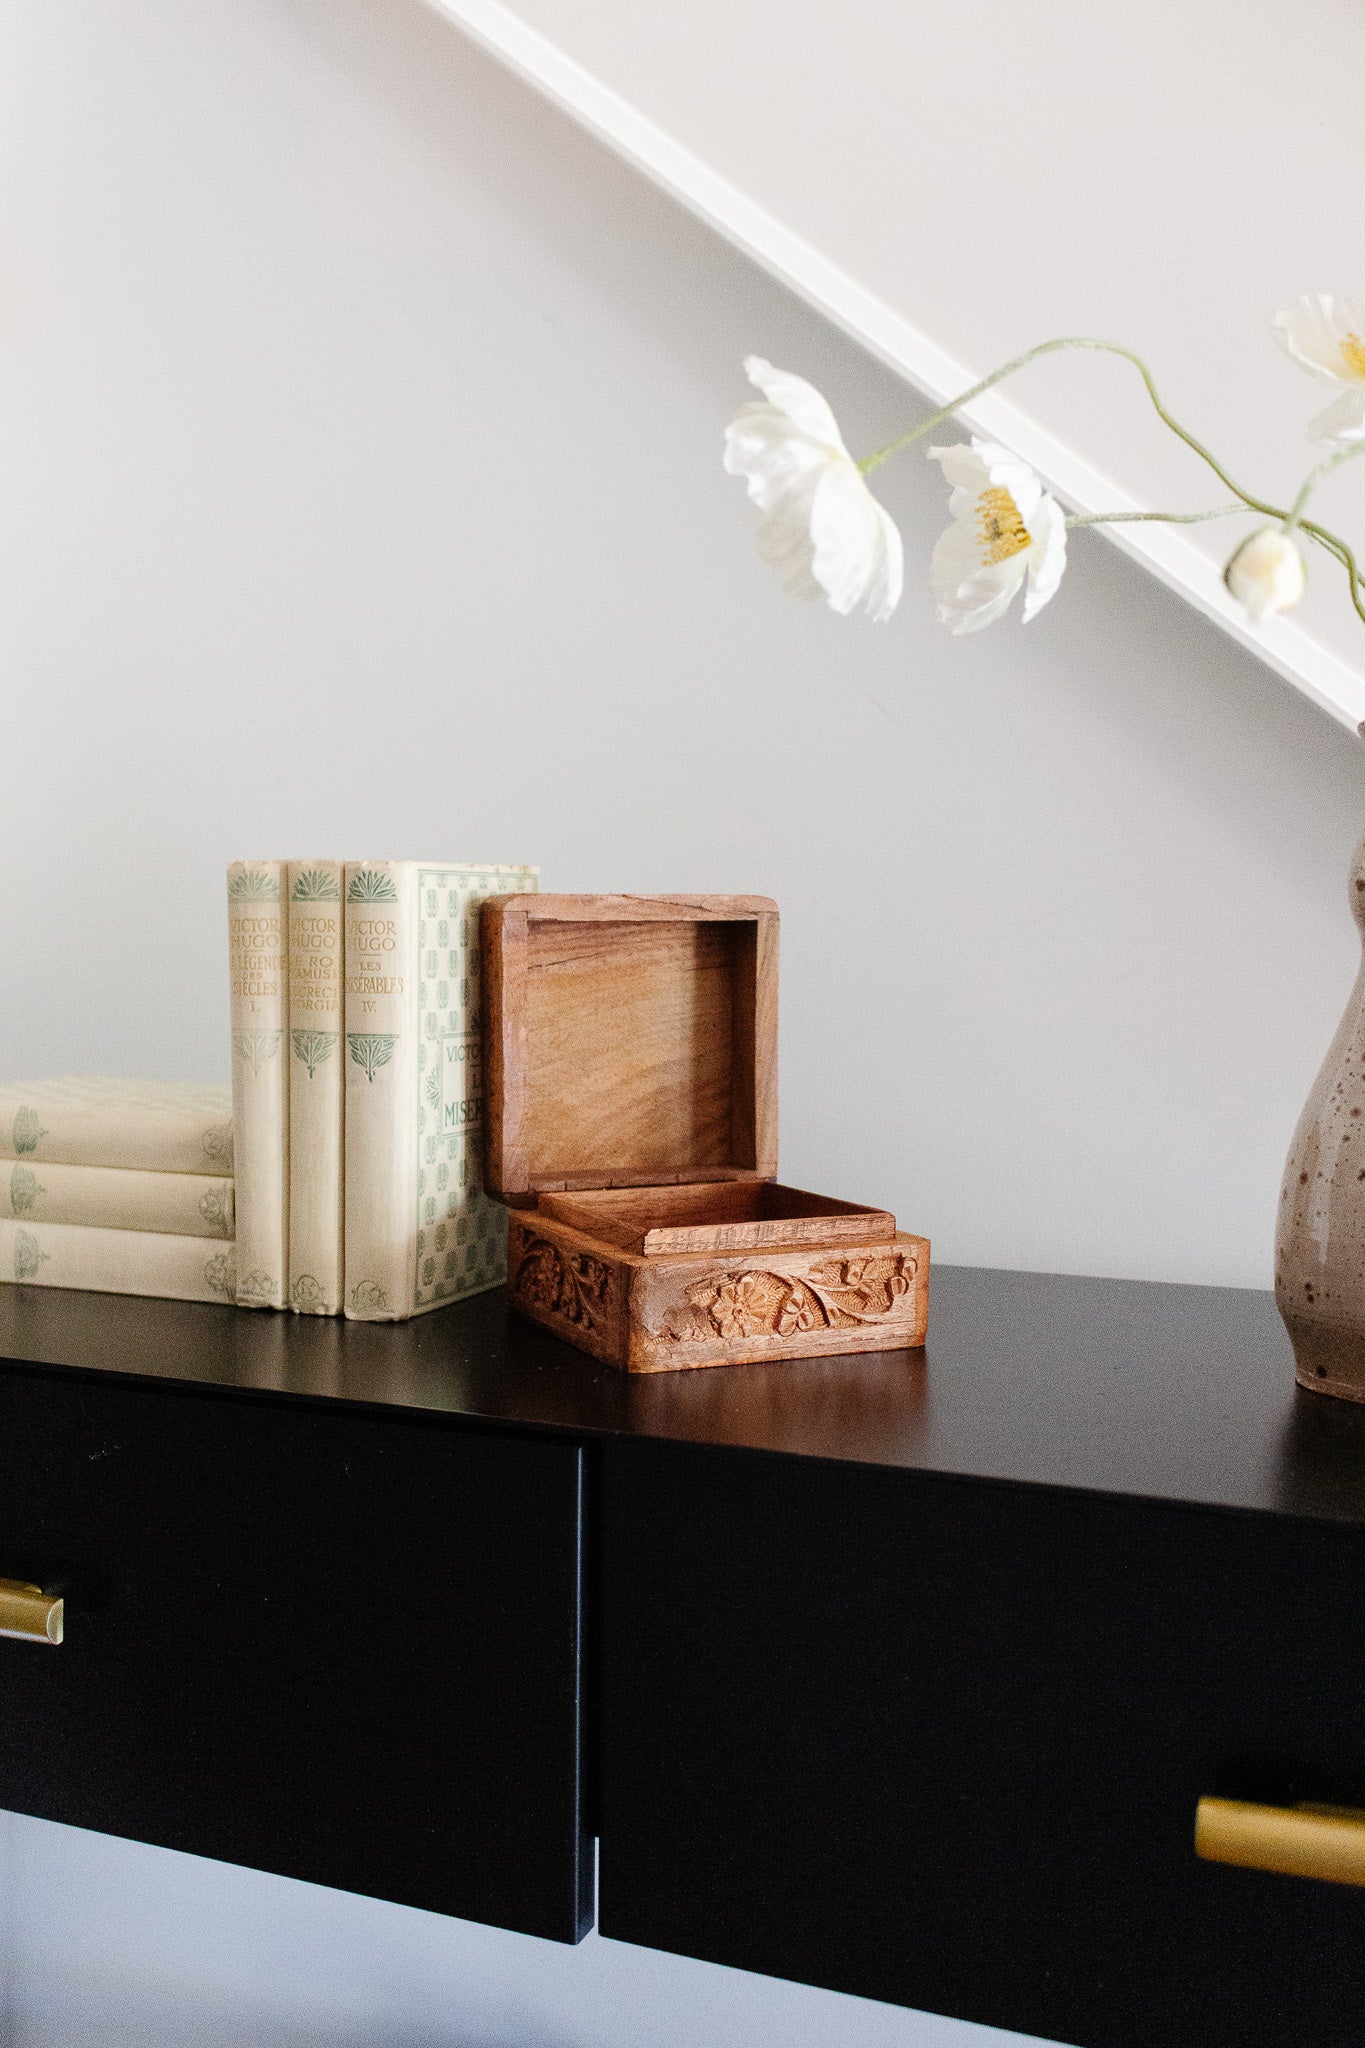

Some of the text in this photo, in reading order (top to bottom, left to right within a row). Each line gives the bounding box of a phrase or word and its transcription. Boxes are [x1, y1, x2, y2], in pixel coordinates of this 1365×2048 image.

[230, 918, 283, 933] VICTOR
[291, 918, 336, 932] VICTOR
[347, 919, 397, 936] VICTOR
[231, 934, 279, 949] HUGO
[291, 934, 336, 949] HUGO
[347, 936, 396, 951] HUGO
[359, 961, 381, 972] LES
[361, 1001, 377, 1013] IV.
[446, 1044, 481, 1062] VICTO
